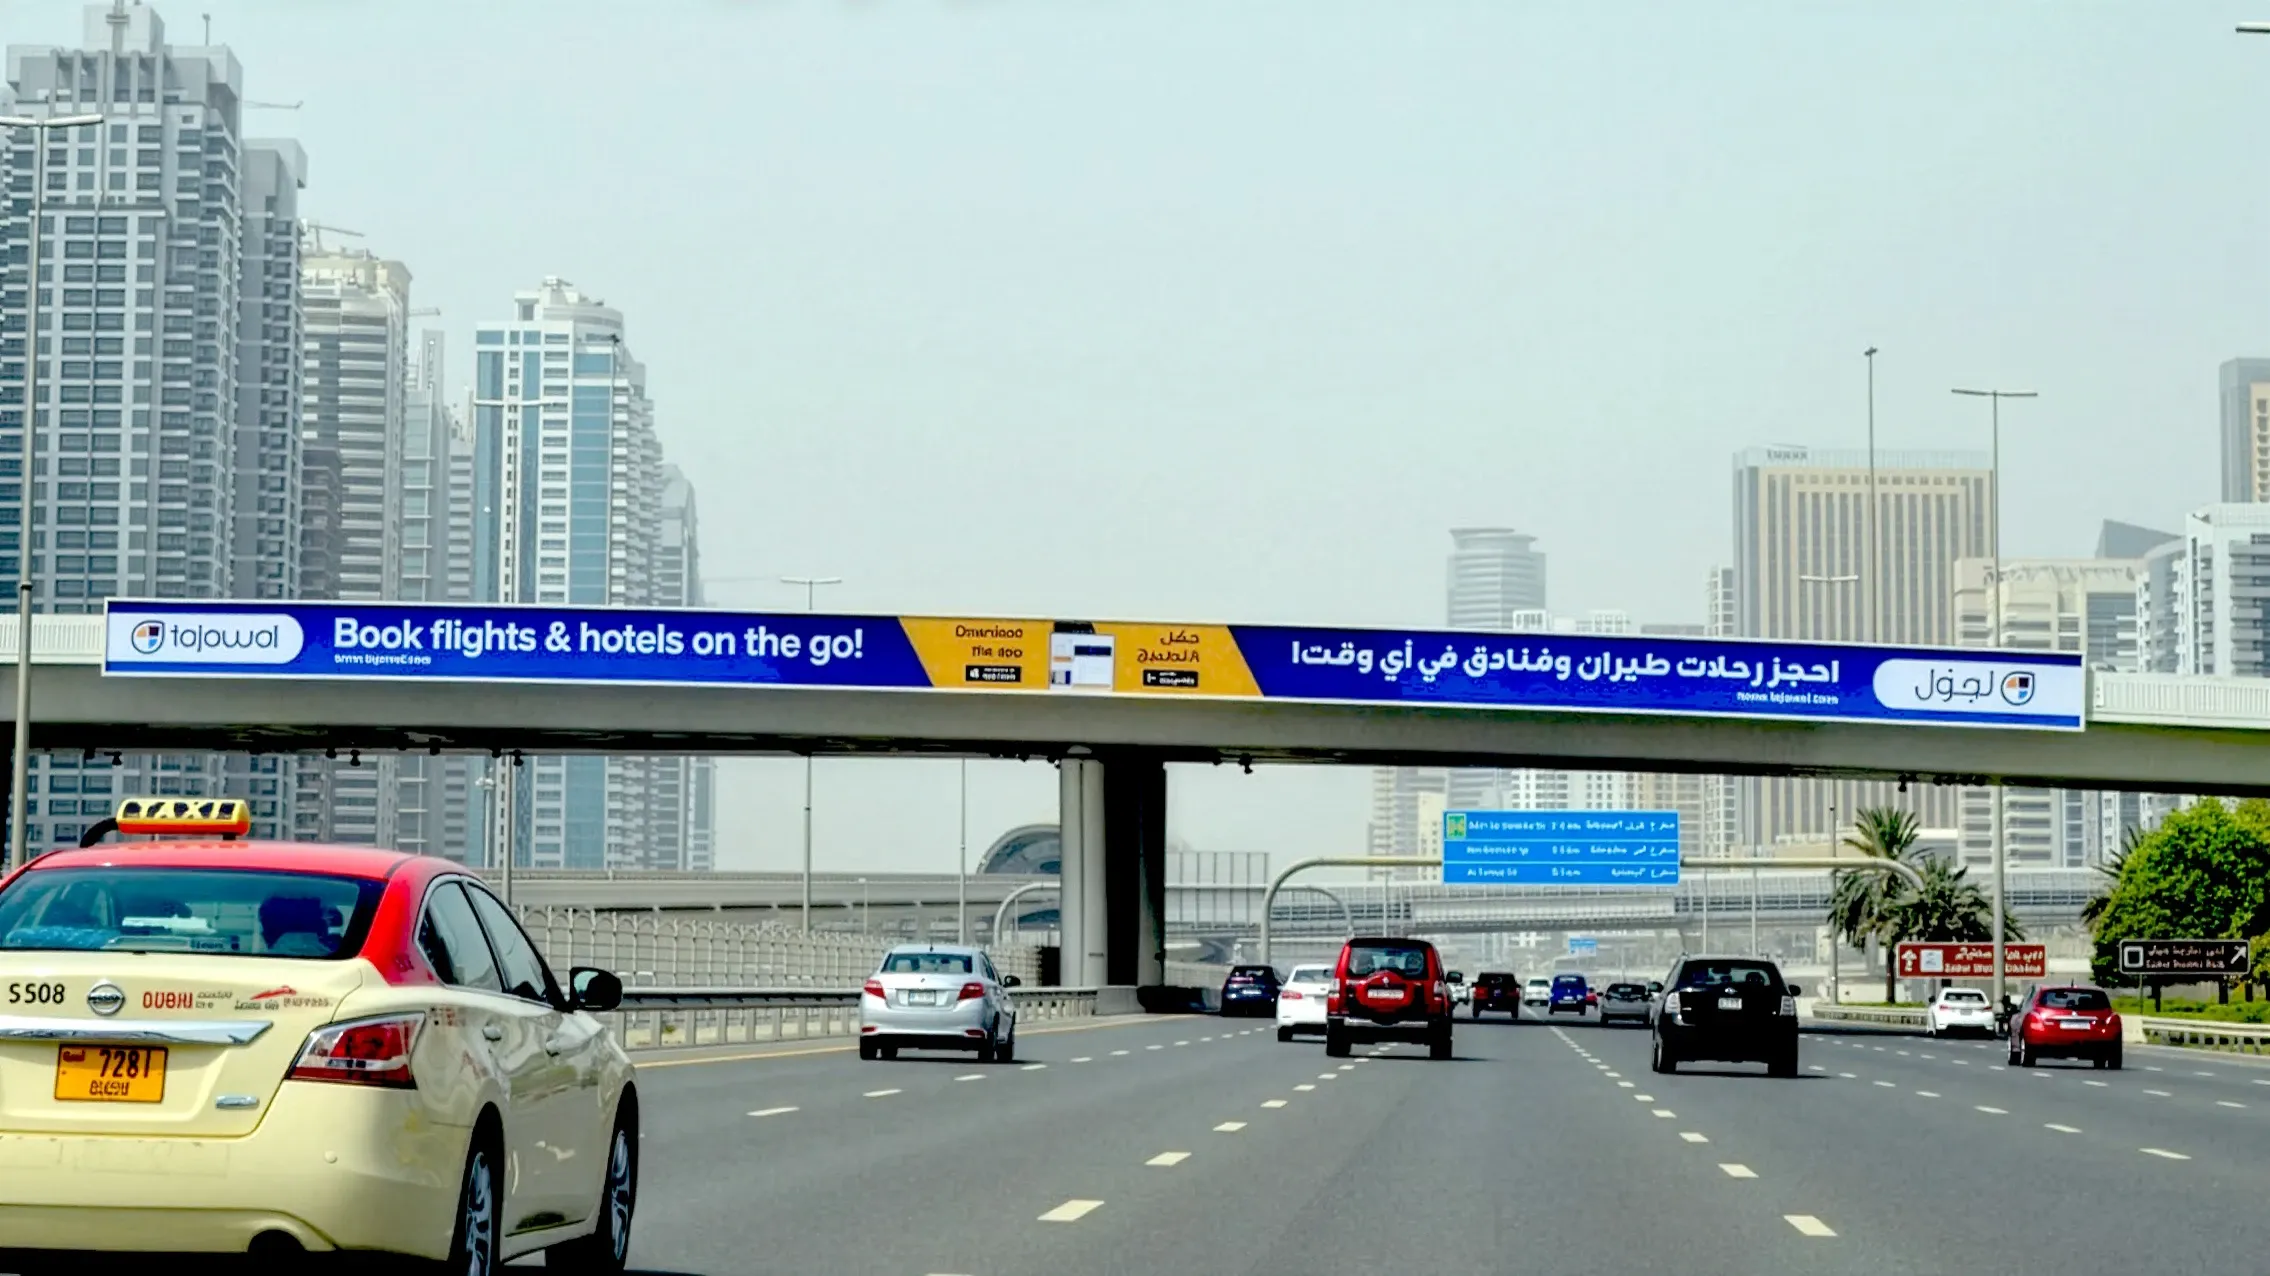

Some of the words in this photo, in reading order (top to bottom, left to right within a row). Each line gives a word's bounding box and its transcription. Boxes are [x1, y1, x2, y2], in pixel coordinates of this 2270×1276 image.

[334, 616, 424, 649] Book
[430, 618, 536, 659] flights
[544, 620, 572, 653] &
[579, 622, 685, 655] hotels
[691, 632, 736, 656] on
[743, 627, 801, 658] the
[809, 628, 864, 666] go!
[1379, 639, 1413, 682] أي
[1417, 645, 1458, 683] في
[1463, 645, 1572, 681] وفنادق
[1577, 651, 1669, 683] طيران
[1676, 655, 1764, 687] رحلات
[1763, 658, 1840, 688] احجز
[99, 1049, 152, 1079] 7281
